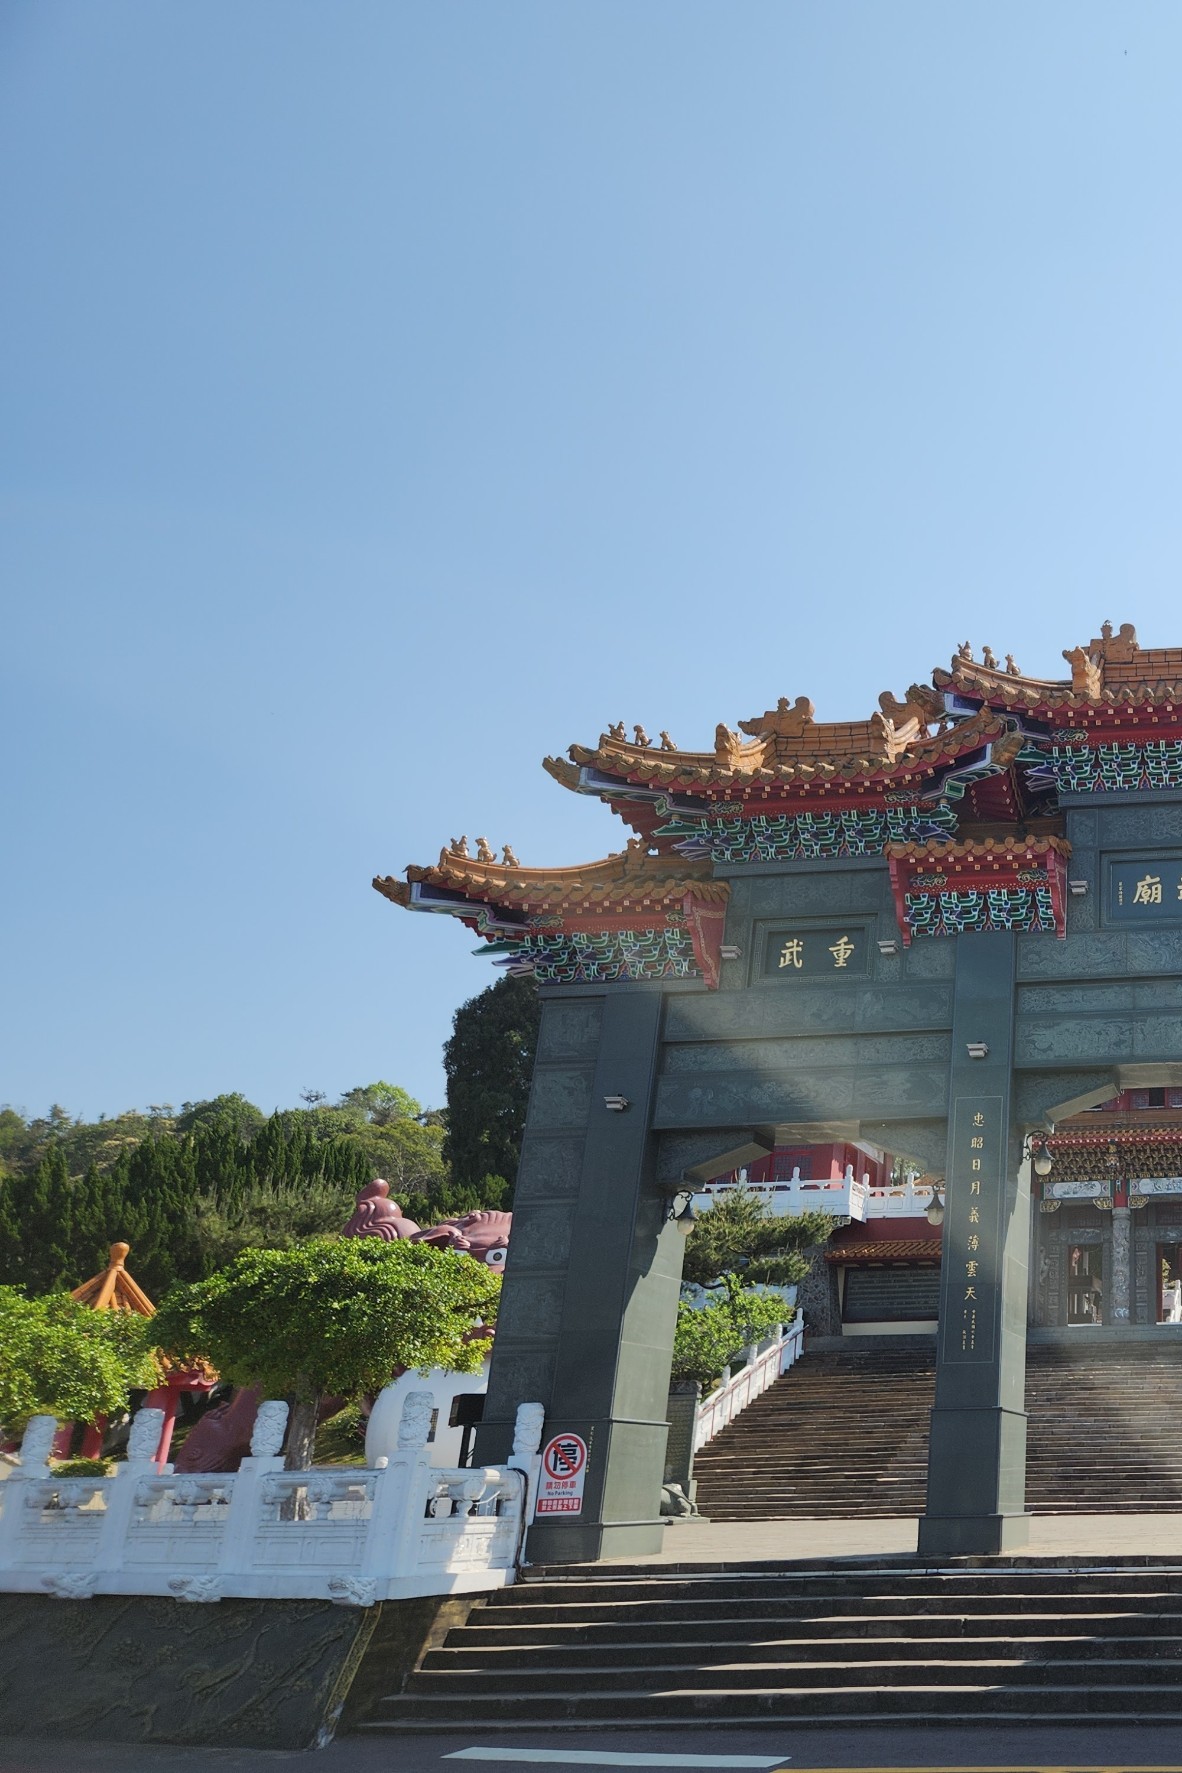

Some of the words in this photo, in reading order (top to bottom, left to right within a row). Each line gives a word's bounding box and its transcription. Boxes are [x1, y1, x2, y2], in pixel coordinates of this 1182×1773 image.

[777, 935, 855, 969] 重武
[964, 1112, 985, 1300] 忠昭日月義薄雲天
[546, 1481, 576, 1490] 請勿停車
